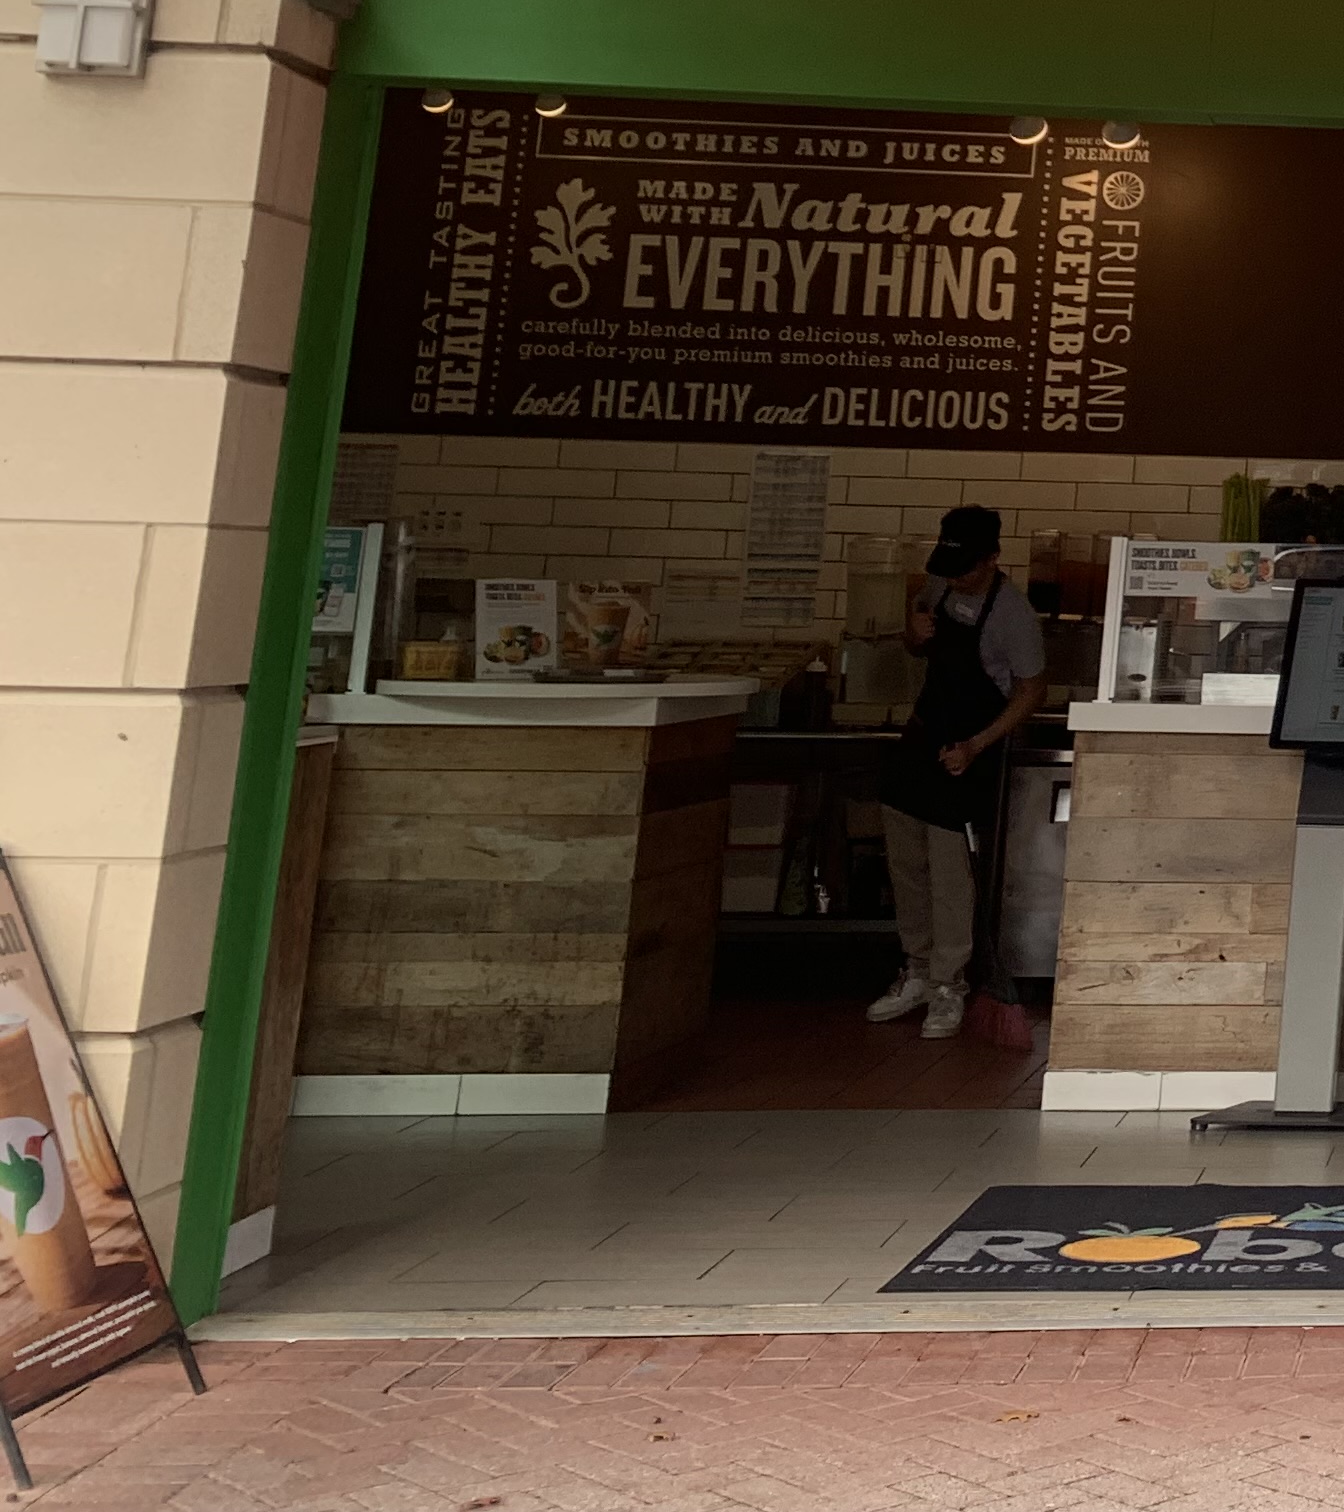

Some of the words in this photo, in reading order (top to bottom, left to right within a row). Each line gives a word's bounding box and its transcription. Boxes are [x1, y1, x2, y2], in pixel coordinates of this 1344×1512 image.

[460, 108, 511, 206] EATS
[563, 127, 780, 154] SMOOTHIES
[794, 138, 869, 159] AND
[883, 141, 1007, 165] JUICES
[1064, 146, 1150, 163] PREMIUM
[637, 179, 738, 202] MADE
[639, 204, 732, 225] WITH
[738, 182, 1023, 239] Natural
[411, 290, 443, 414] GREAT
[428, 108, 465, 270] TASTING
[622, 233, 1017, 322] EVERYTHING
[1092, 220, 1140, 344] FRUITS
[435, 223, 497, 415] HEALTHY
[1041, 169, 1099, 432] VEGETABLES
[518, 341, 666, 363] good-for-you
[672, 346, 773, 365] premium
[779, 351, 893, 368] smoothies
[900, 353, 940, 369] and
[945, 354, 1019, 373] juices.
[521, 318, 621, 338] carefully
[627, 320, 721, 339] blended
[728, 324, 772, 341] into
[778, 325, 886, 347] delicious,
[893, 330, 1022, 352] wholesome,
[512, 383, 582, 417] both
[591, 379, 753, 423] HEALTHY
[754, 393, 819, 425] and
[821, 387, 1010, 431] DELICIOUS
[1085, 357, 1129, 432] AND
[910, 1263, 1012, 1275] Fruit
[1024, 1262, 1286, 1275] Smoothies
[1295, 1262, 1331, 1274] &
